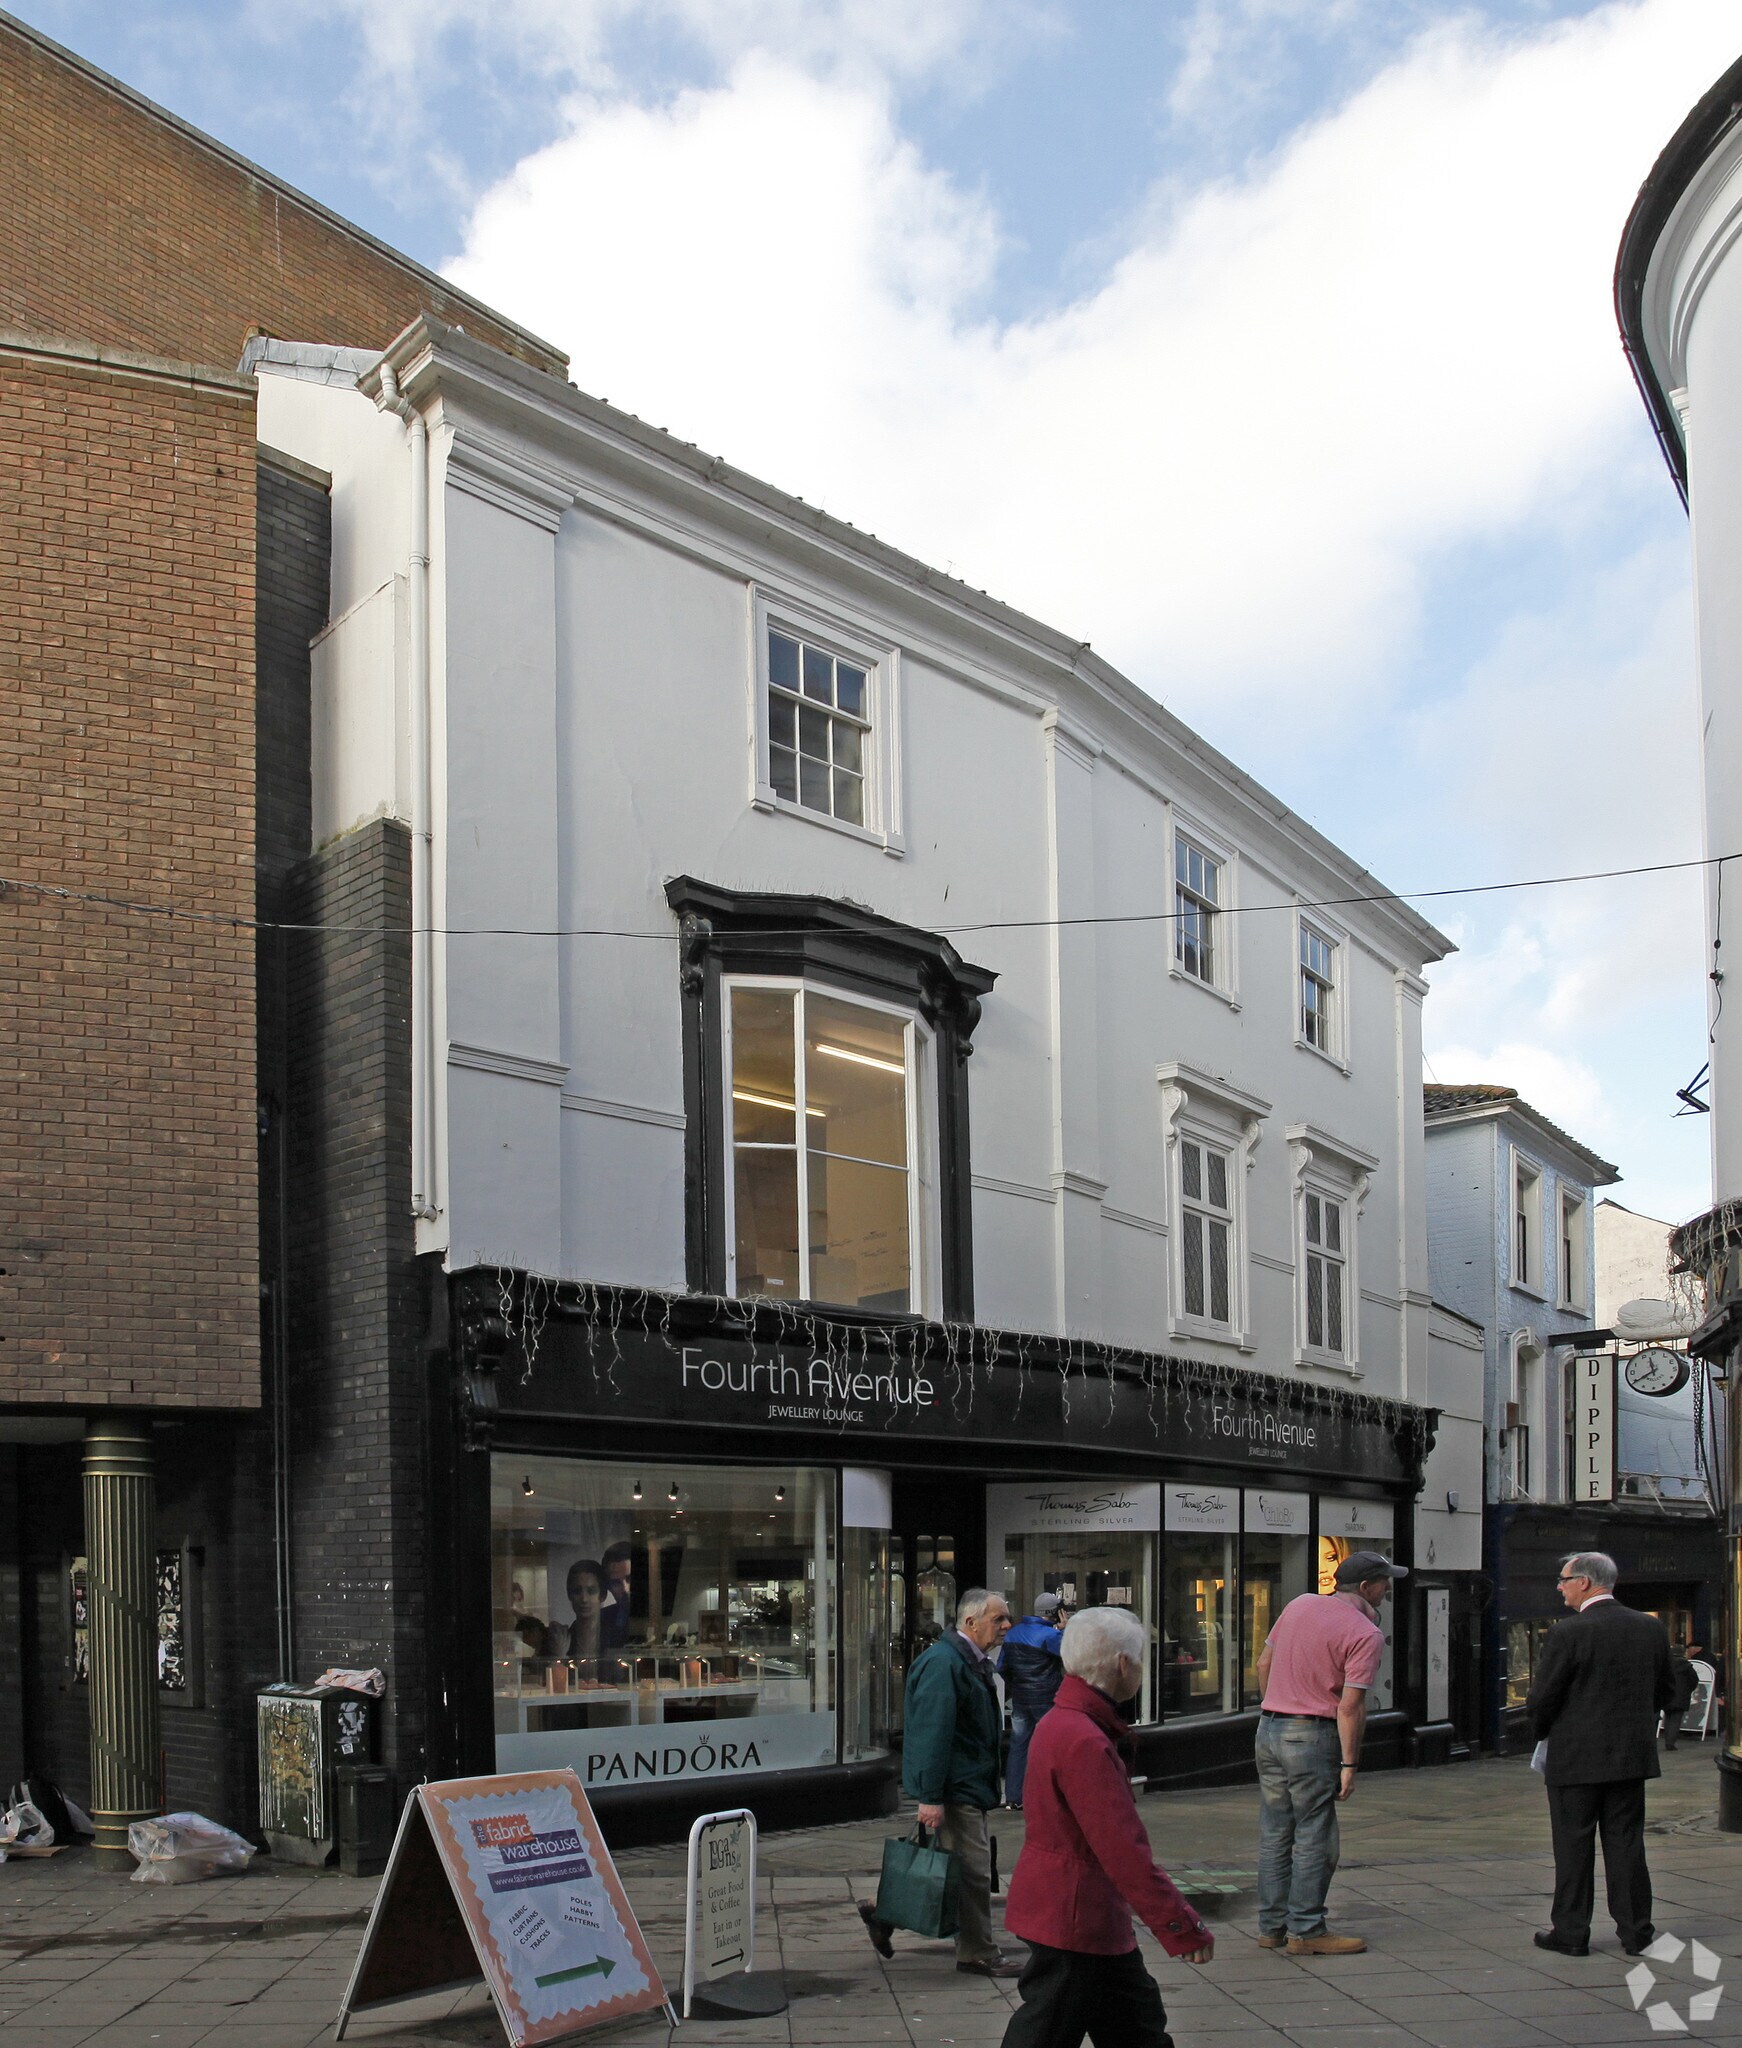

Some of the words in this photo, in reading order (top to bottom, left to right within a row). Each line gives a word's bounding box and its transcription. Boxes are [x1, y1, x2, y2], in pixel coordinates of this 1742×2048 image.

[682, 1347, 800, 1396] Fourth
[768, 1405, 820, 1419] JEWELLERY
[822, 1408, 863, 1422] LOUNGE
[1213, 1406, 1262, 1440] Fourth
[1588, 1359, 1601, 1498] DIPPLE
[1025, 1493, 1087, 1512] Thomas
[1085, 1493, 1138, 1513] Sabo
[1176, 1492, 1203, 1512] Thomas
[1201, 1495, 1228, 1513] Sabo
[1031, 1517, 1090, 1526] STERLING
[1099, 1517, 1133, 1525] SILVER
[587, 1741, 761, 1782] PANDORA
[476, 1824, 488, 1843] the
[486, 1821, 531, 1842] fabric
[503, 1836, 580, 1860] warehouse
[494, 1864, 586, 1887] www.fabricwarehouse.co.uk
[708, 1885, 727, 1899] Great
[728, 1879, 744, 1893] Food
[569, 1906, 593, 1917] HABBY
[570, 1896, 592, 1907] POLES
[711, 1901, 717, 1914] &
[718, 1898, 740, 1911] Coffee
[508, 1904, 528, 1925] FABRIC
[512, 1910, 539, 1937] CURTAINS
[564, 1914, 600, 1929] PATTERNS
[520, 1917, 546, 1945] CUSHIONS
[713, 1921, 724, 1934] Eat
[725, 1918, 733, 1931] in
[734, 1917, 742, 1928] or
[529, 1929, 551, 1950] TRACKS
[714, 1931, 741, 1949] Takeout
